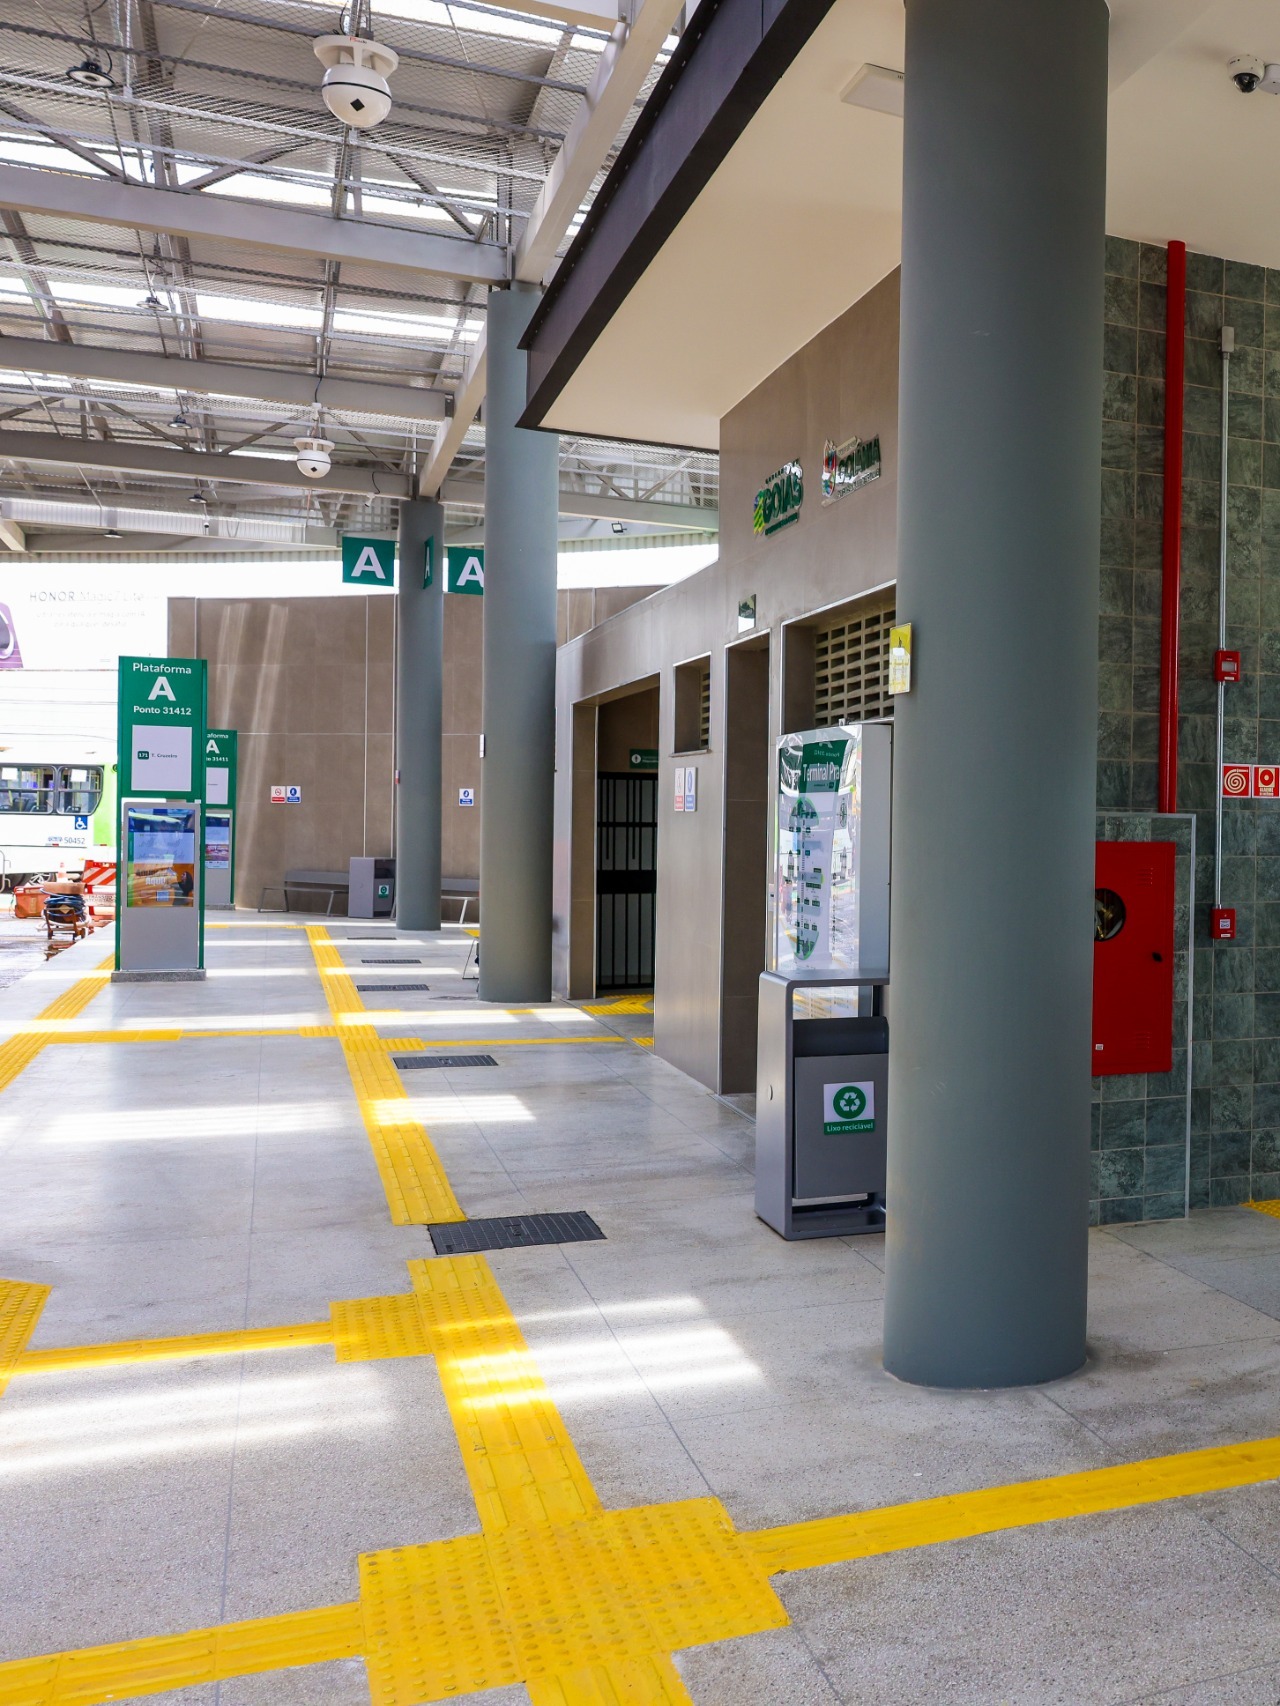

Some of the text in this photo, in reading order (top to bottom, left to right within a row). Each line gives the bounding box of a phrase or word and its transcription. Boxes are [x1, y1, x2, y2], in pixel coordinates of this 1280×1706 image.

[351, 546, 386, 579] A
[456, 556, 485, 588] A
[29, 591, 75, 602] HONOR
[132, 662, 192, 674] Plataforma
[147, 676, 177, 701] A
[133, 705, 192, 716] Ponto 31412
[206, 739, 220, 754] A
[803, 761, 829, 782] Terminal
[842, 1122, 874, 1131] reciclável
